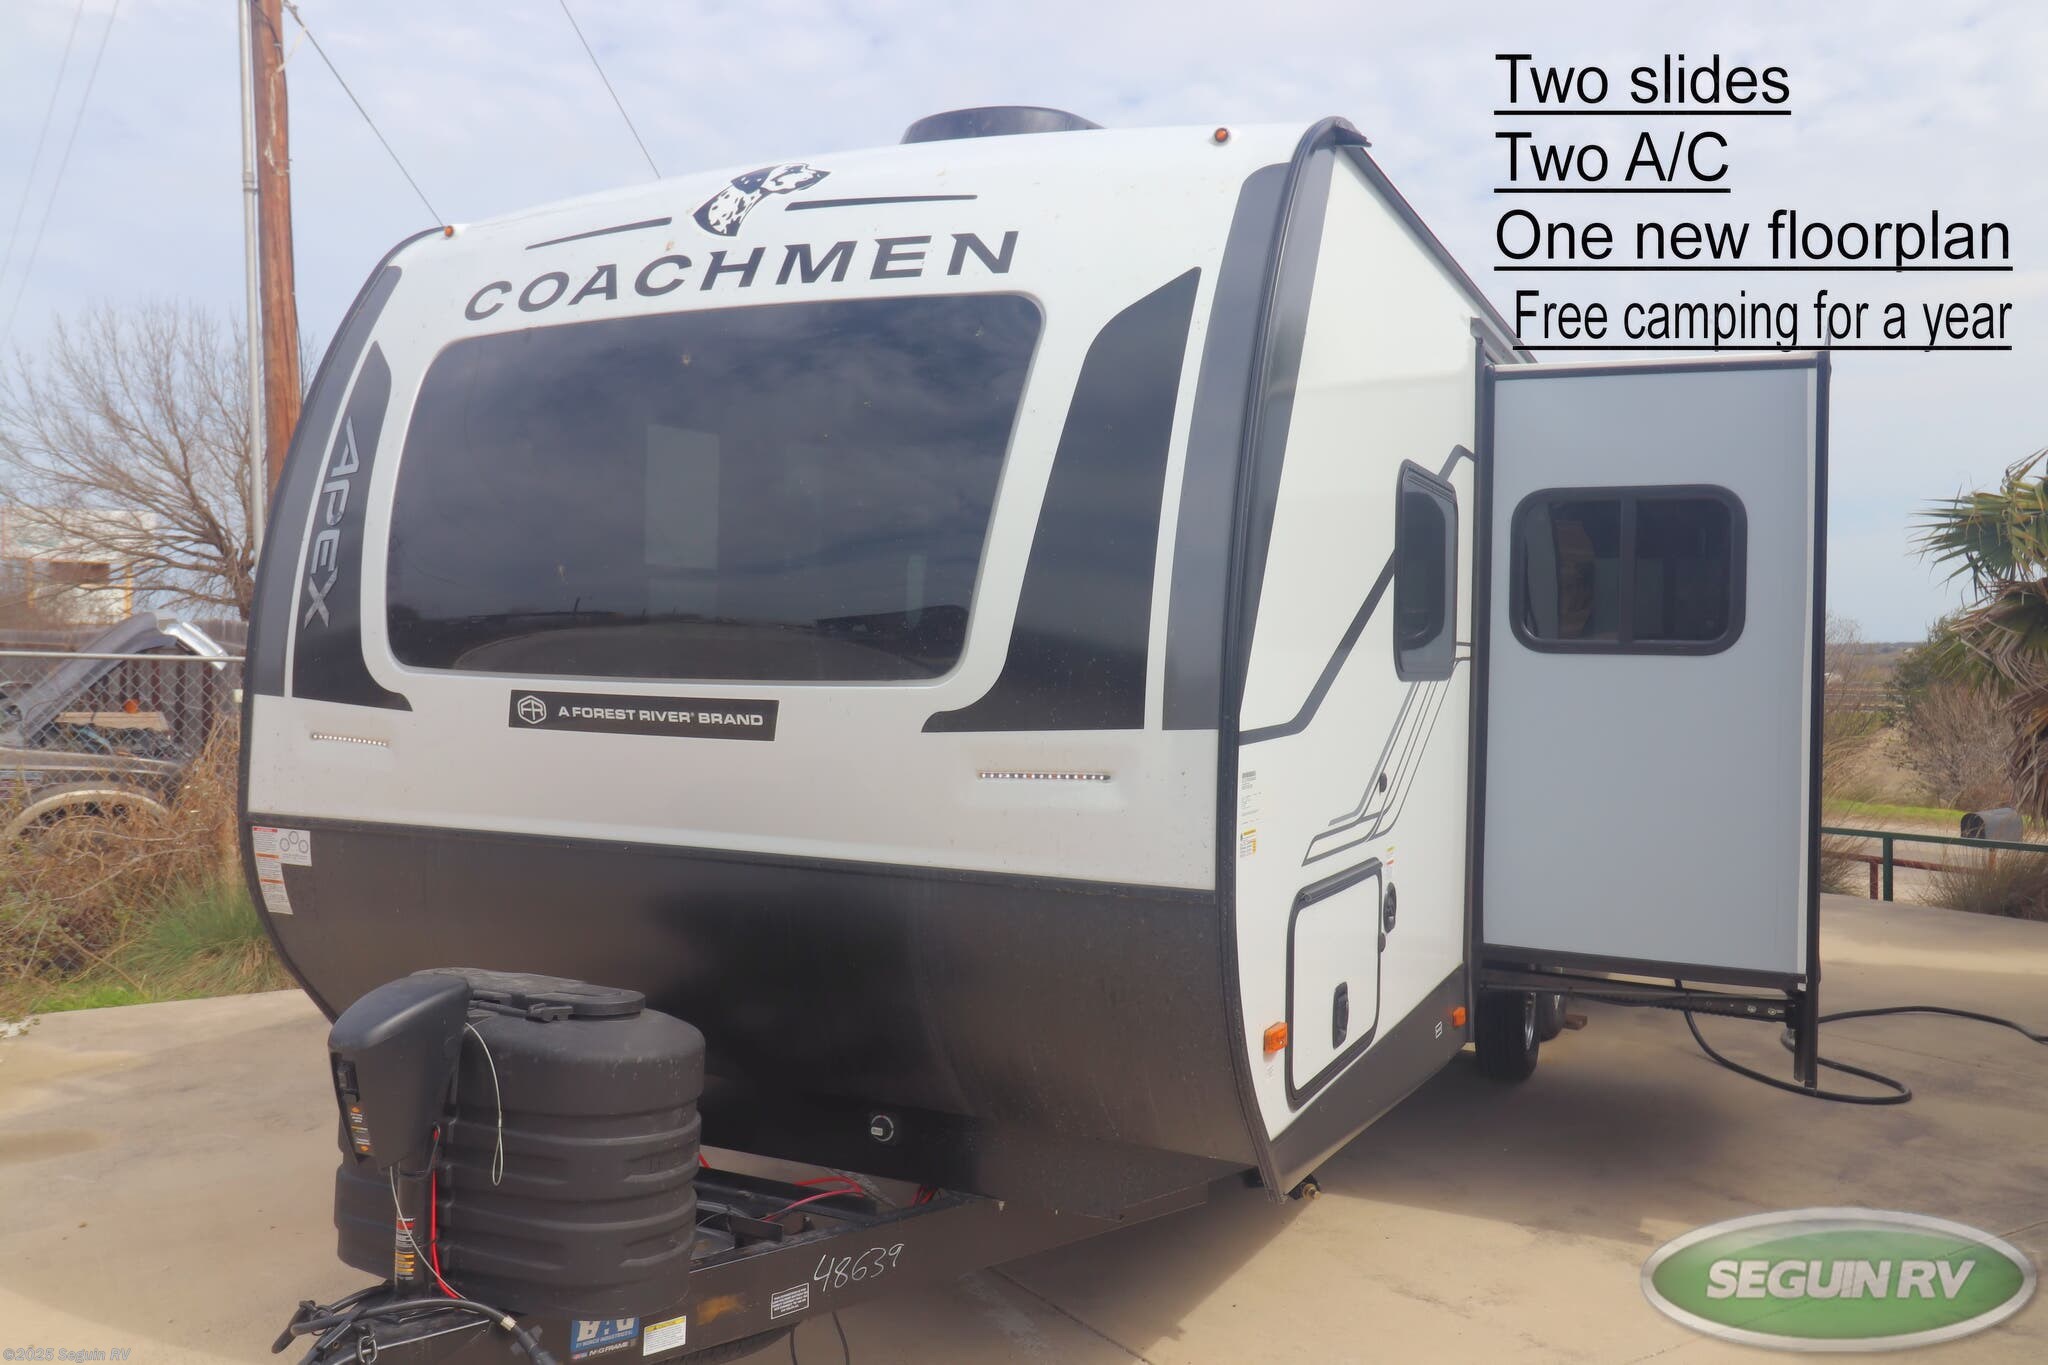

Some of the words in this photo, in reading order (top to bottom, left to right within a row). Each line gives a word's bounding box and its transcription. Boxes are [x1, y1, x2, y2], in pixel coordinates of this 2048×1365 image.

[464, 231, 1019, 321] COACHMEN
[304, 416, 360, 629] APEX
[558, 706, 570, 717] A
[572, 706, 636, 720] FOREST
[698, 712, 763, 726] BRAND
[814, 1244, 904, 1292] 48639
